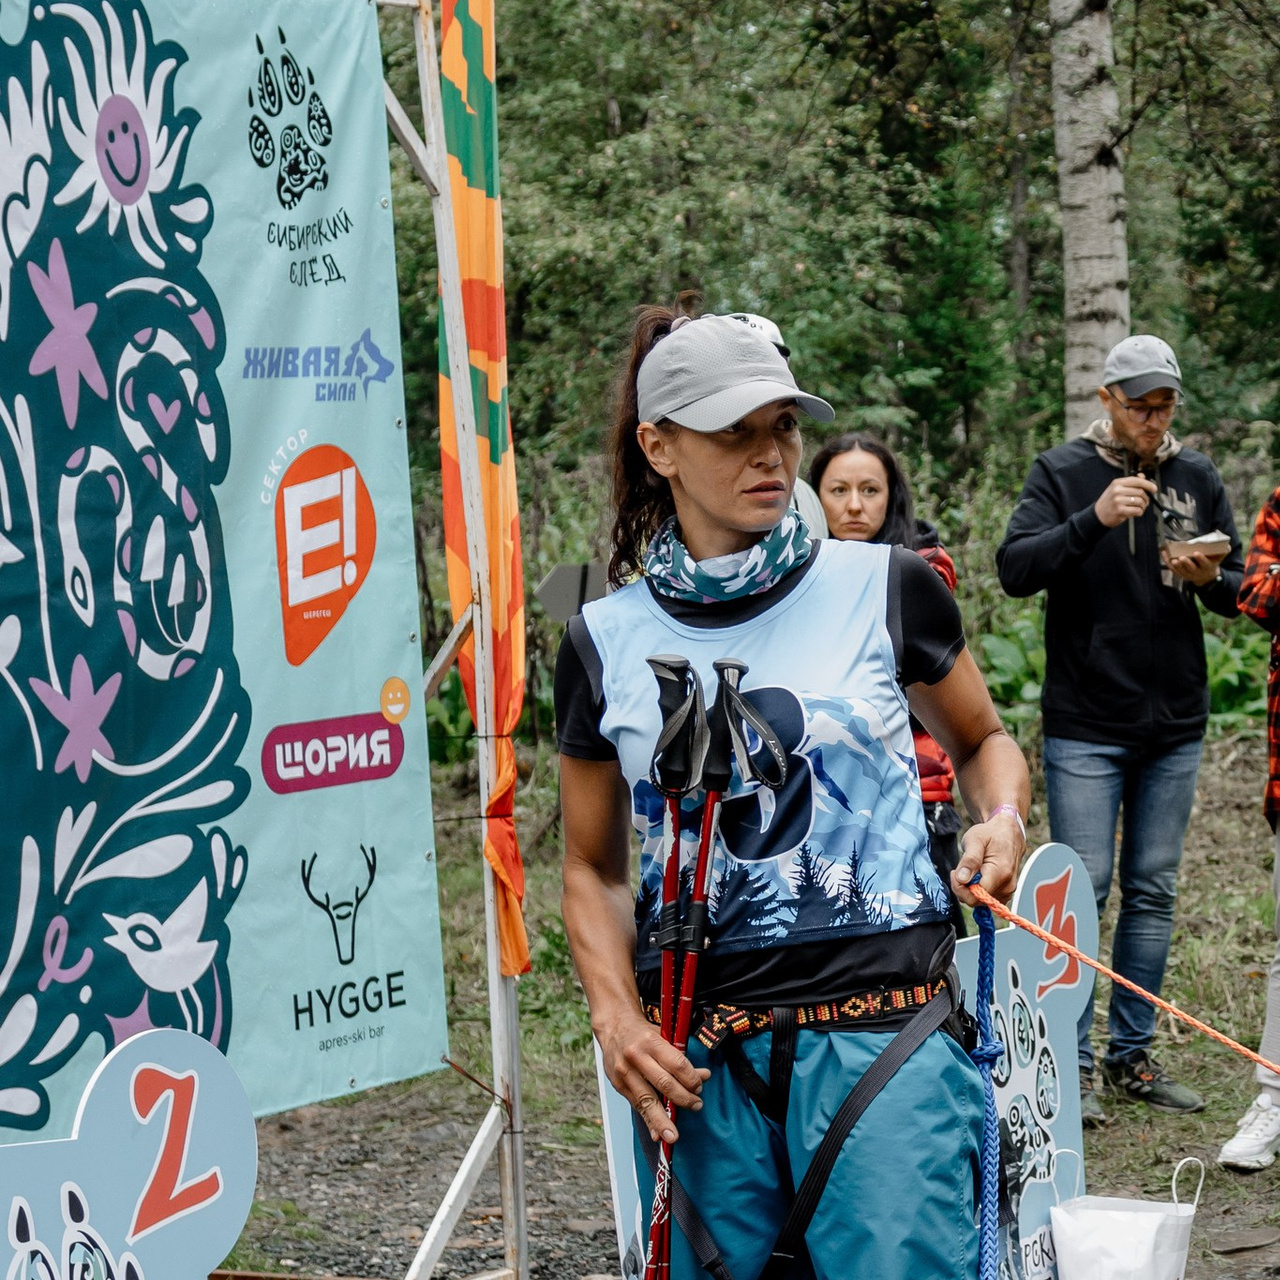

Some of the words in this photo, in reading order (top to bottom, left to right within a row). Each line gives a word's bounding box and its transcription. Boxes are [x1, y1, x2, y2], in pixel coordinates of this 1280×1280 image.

[267, 207, 354, 251] СИБИРСКИЙ
[242, 345, 341, 379] ЖИВАЯ
[315, 382, 357, 402] СИЛА
[260, 427, 308, 505] СЕКТОР
[274, 728, 391, 781] ШОРИЯ
[1035, 865, 1080, 1001] 3
[293, 970, 407, 1031] HYGGE
[318, 1027, 367, 1052] apres-ski
[368, 1025, 385, 1040] bar
[128, 1064, 222, 1243] 2
